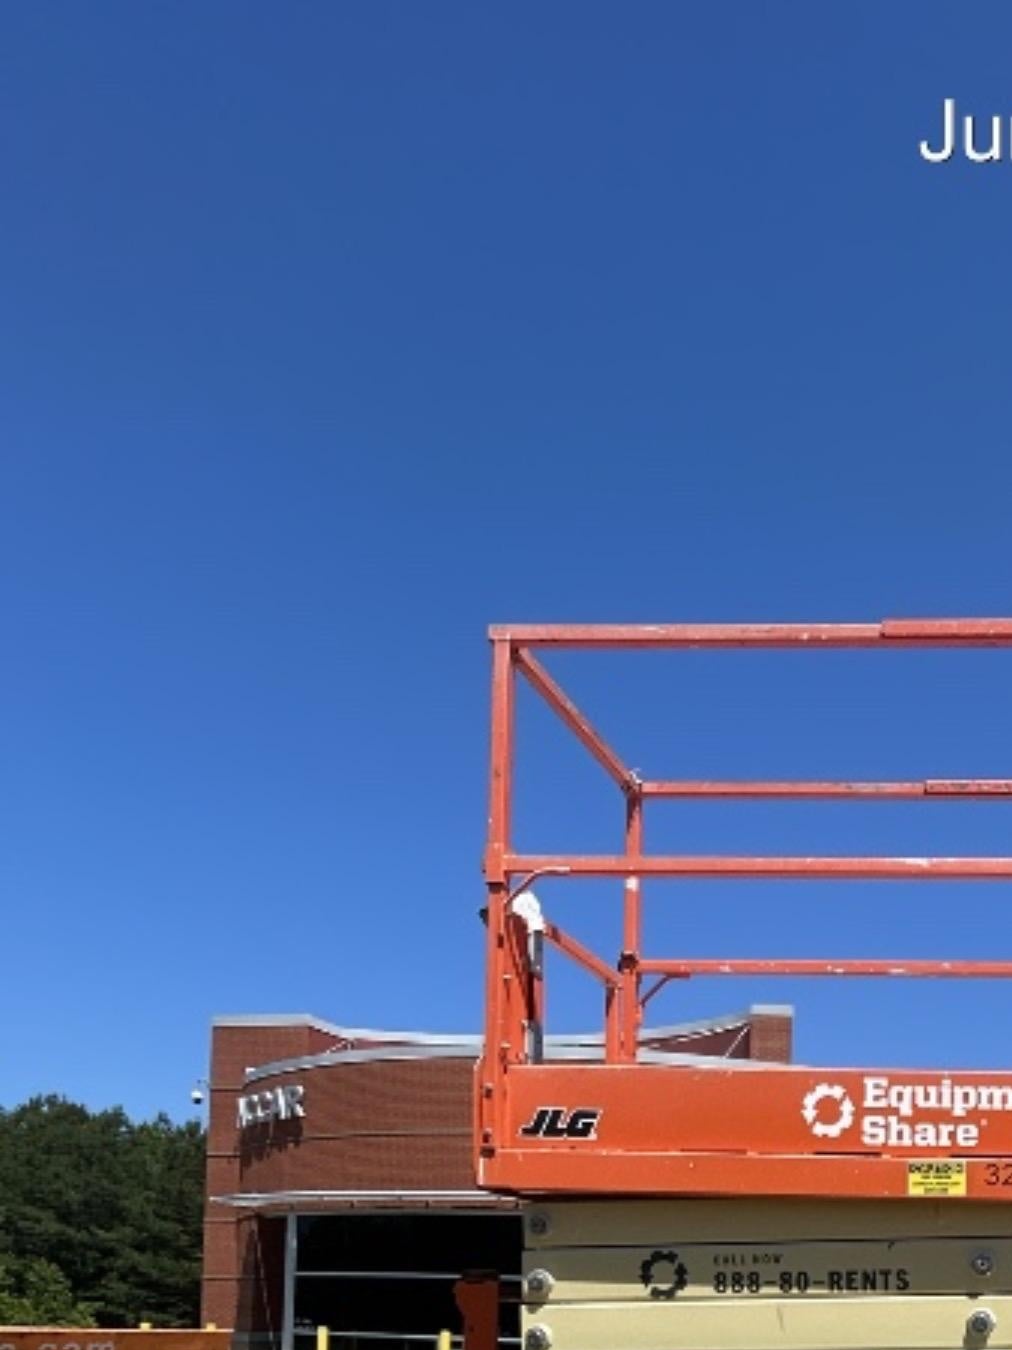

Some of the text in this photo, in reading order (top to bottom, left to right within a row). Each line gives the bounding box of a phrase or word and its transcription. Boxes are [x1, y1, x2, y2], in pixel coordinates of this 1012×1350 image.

[517, 1106, 603, 1141] JLG
[861, 1114, 980, 1147] Share
[713, 1268, 911, 1294] 888-80-RENTS
